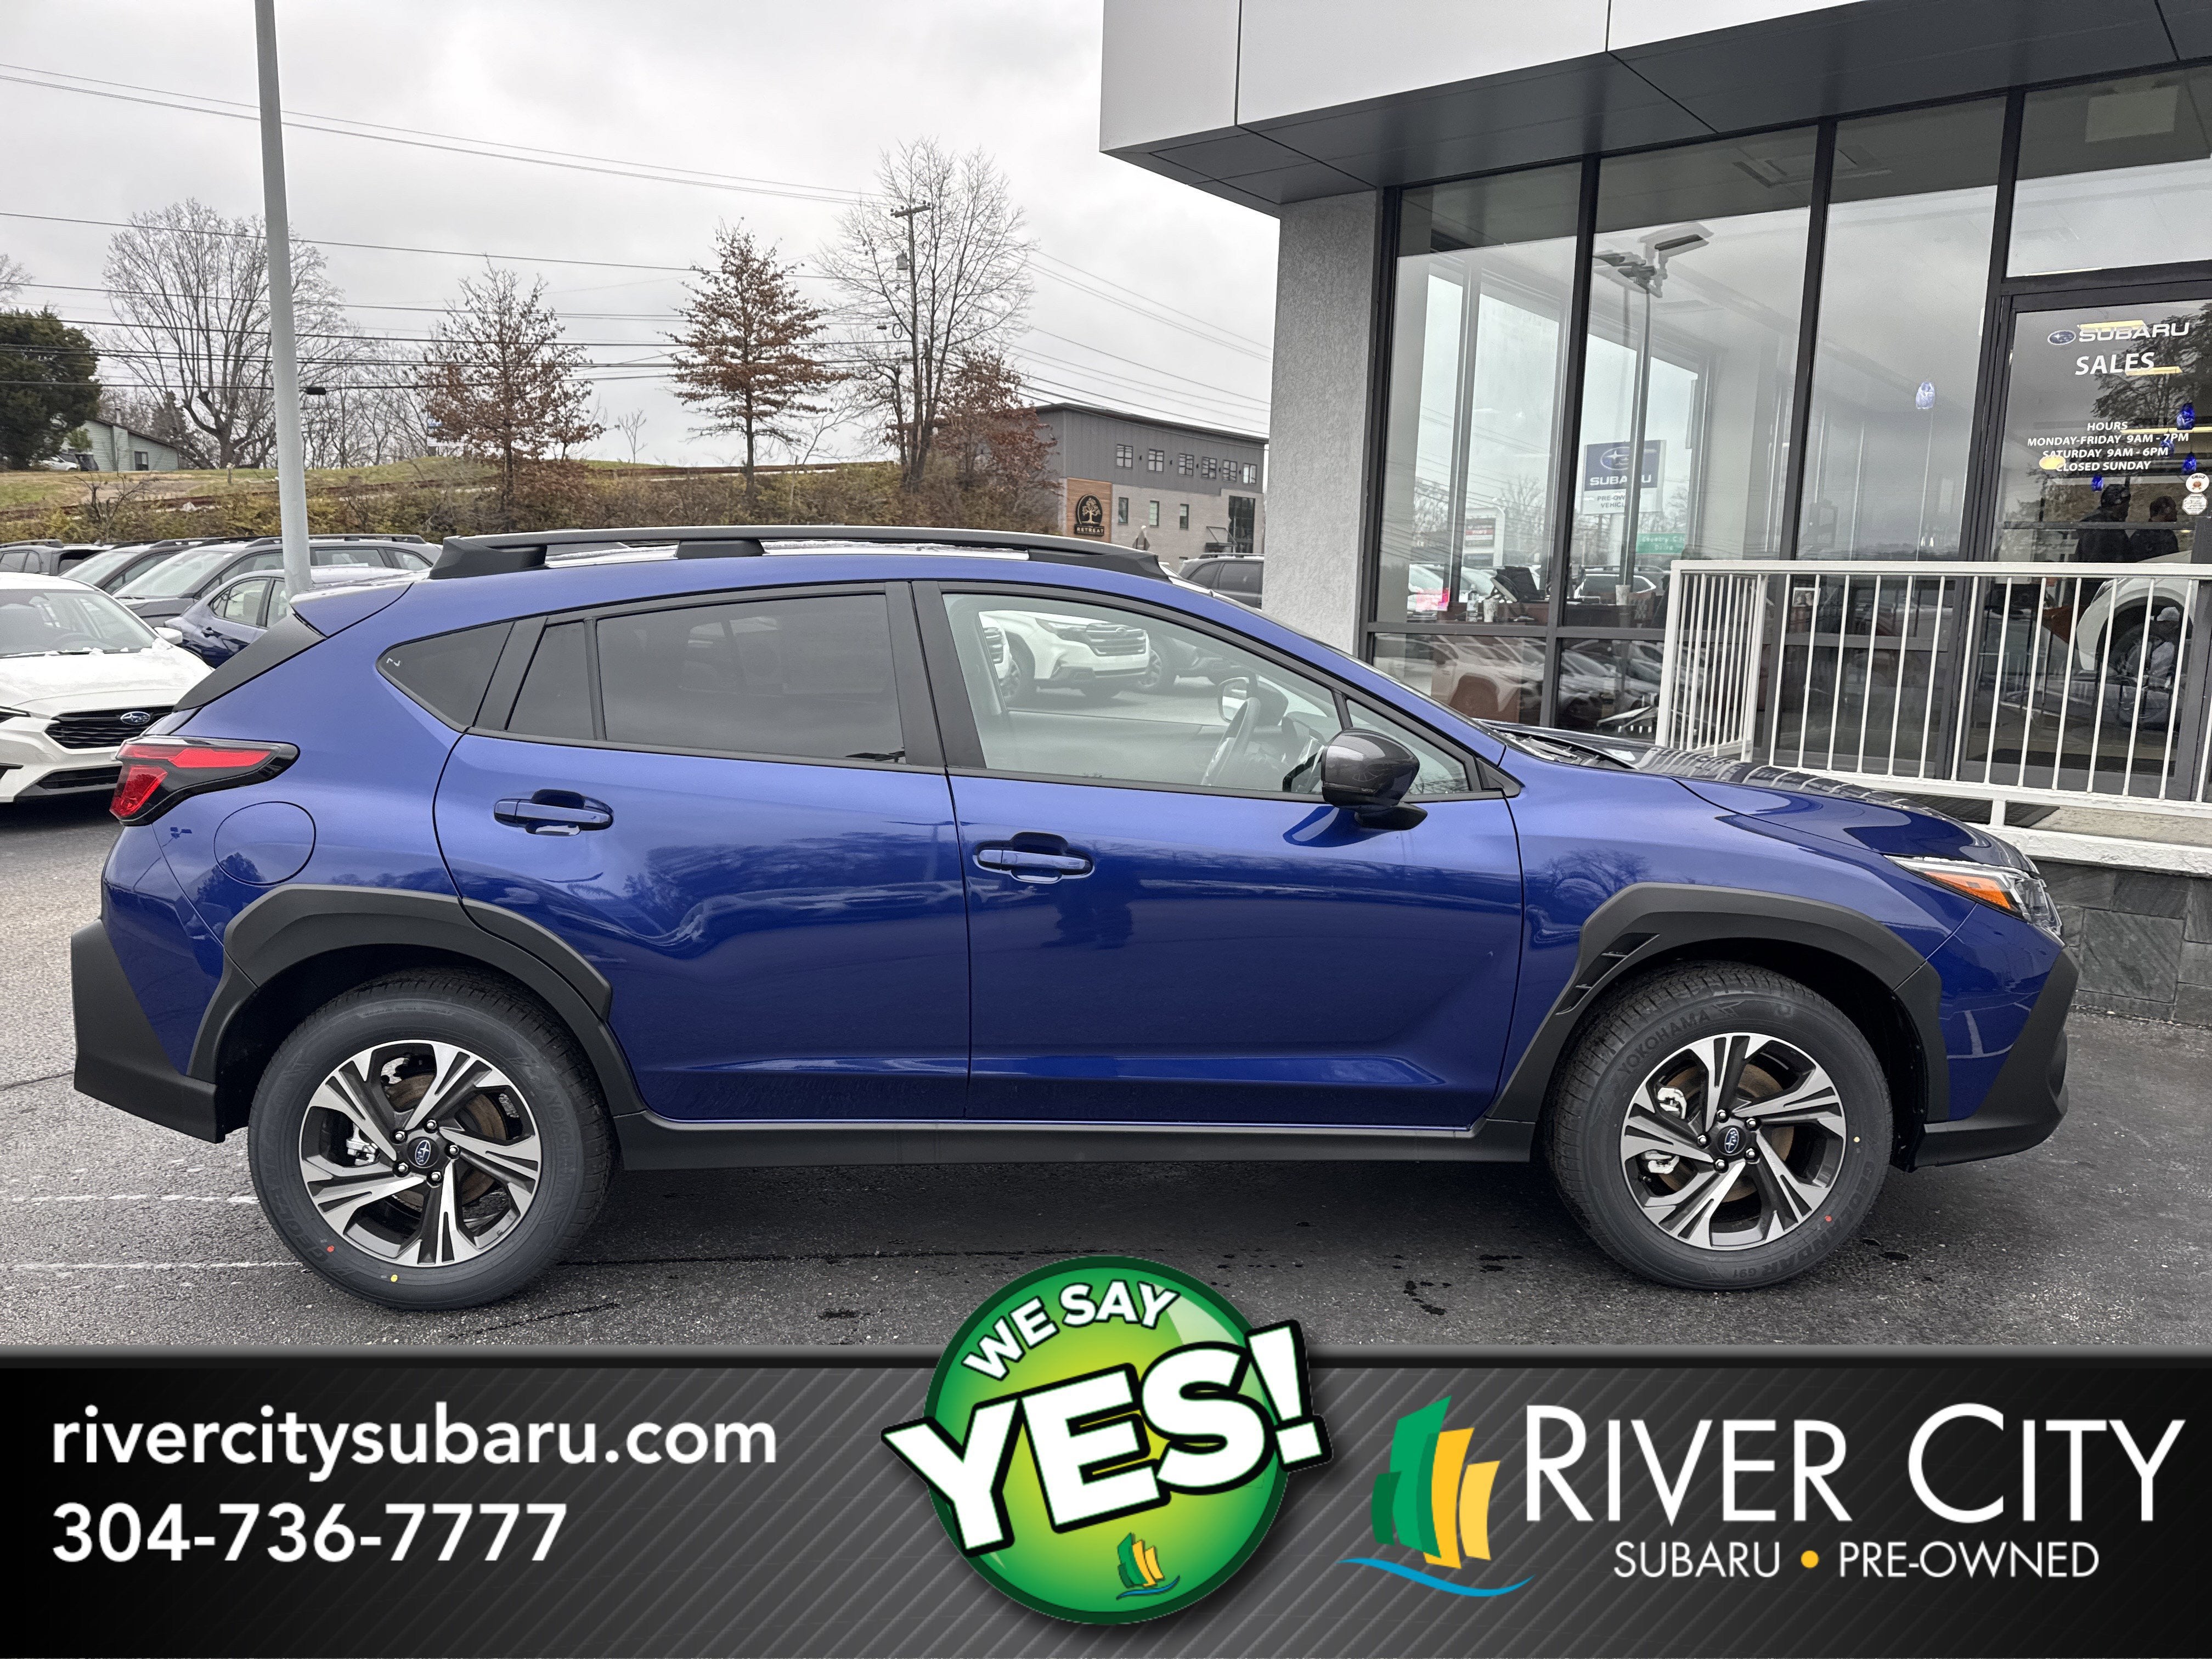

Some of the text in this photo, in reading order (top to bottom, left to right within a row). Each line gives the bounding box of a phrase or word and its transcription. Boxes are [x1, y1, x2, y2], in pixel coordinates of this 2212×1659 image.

[2078, 323, 2190, 342] SUBARU
[2075, 352, 2155, 375] SALES
[2086, 421, 2128, 431] HOURS
[2027, 435, 2121, 446] MONDAY-FRIDAY
[2126, 434, 2153, 443] 9AM
[2163, 433, 2189, 442] 7PM
[2042, 449, 2102, 459] SATURDAY
[2107, 448, 2133, 458] 9AM
[2142, 447, 2168, 456] 6PM
[2056, 461, 2151, 472] CLOSED SUNDAY
[1590, 474, 1652, 486] SUBAU
[1617, 1009, 1711, 1075] YOKOHAMA
